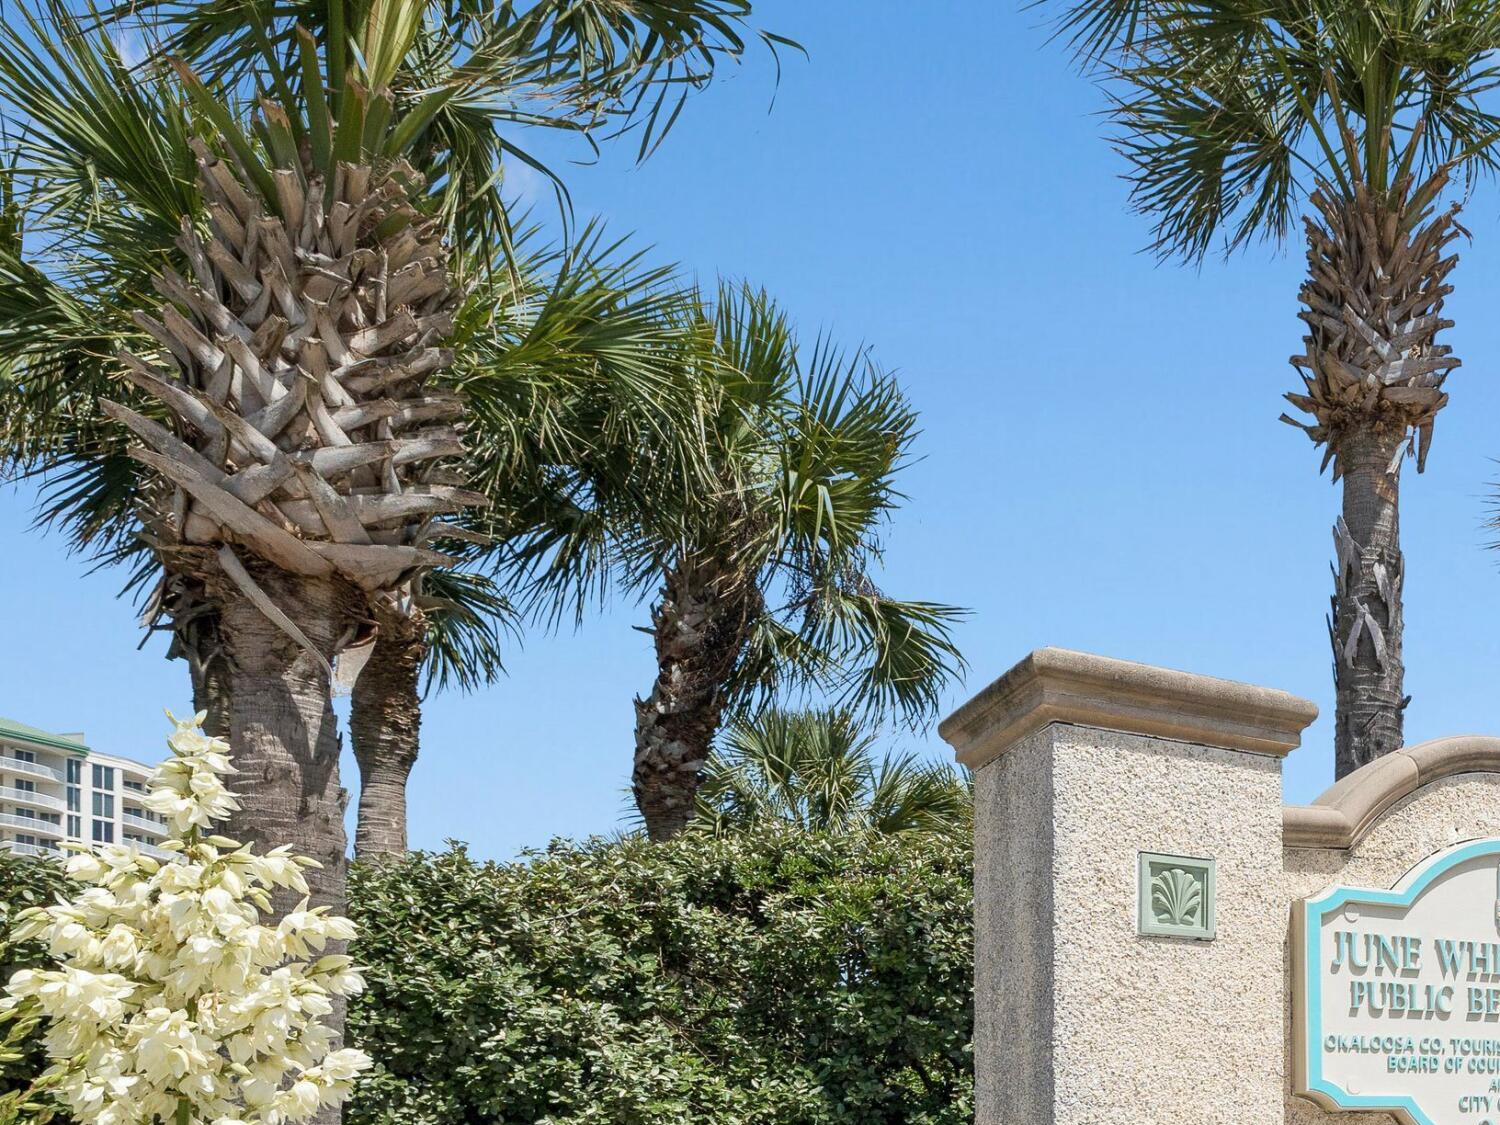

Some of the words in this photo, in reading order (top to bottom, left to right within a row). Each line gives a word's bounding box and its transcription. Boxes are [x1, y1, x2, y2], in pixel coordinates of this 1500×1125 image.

[1331, 931, 1423, 974] JUNE
[1349, 981, 1454, 1018] PUBLIC
[1323, 1035, 1415, 1055] OKALOOSA
[1386, 1055, 1440, 1074] BOARD
[1444, 1056, 1463, 1074] OF
[1458, 1096, 1492, 1113] CITY
